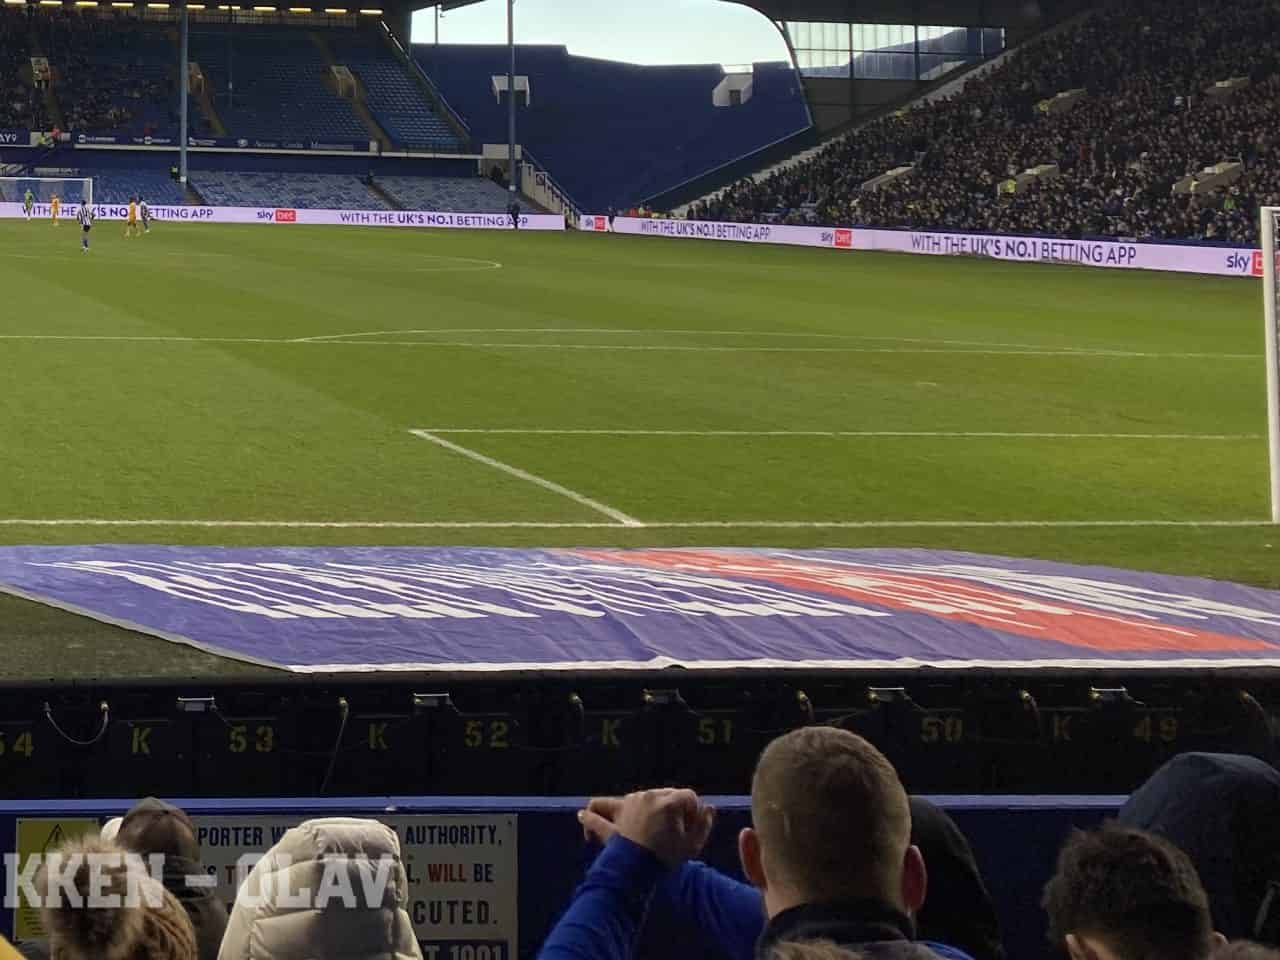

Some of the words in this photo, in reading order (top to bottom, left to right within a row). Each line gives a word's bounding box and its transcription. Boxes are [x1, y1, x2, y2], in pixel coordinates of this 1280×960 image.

[147, 208, 189, 219] ETTING
[191, 209, 214, 219] APP
[257, 210, 274, 222] sky
[340, 212, 370, 224] WITH
[373, 213, 395, 224] THE
[398, 214, 424, 225] UK'S
[427, 214, 453, 225] NO.1
[457, 215, 505, 227] BETTING
[641, 220, 658, 233] WITH
[660, 221, 674, 235] THE
[677, 222, 695, 236] UK'S
[697, 223, 714, 237] NO.1
[717, 224, 752, 240] BETTING
[754, 226, 770, 241] APP
[911, 234, 941, 252] WITH
[944, 236, 967, 254] THE
[970, 238, 1001, 257] UK'S
[1005, 240, 1037, 259] NO.1
[1042, 242, 1103, 263] BETTING
[1107, 246, 1136, 265] APP
[1227, 251, 1250, 273] sky
[131, 726, 151, 755] K
[229, 726, 275, 753] 53
[368, 722, 388, 750] K
[464, 721, 511, 749] 52
[697, 717, 735, 745] 51
[405, 824, 503, 847] AUTHORITY,
[427, 863, 467, 883] WILL
[473, 863, 494, 883] BE
